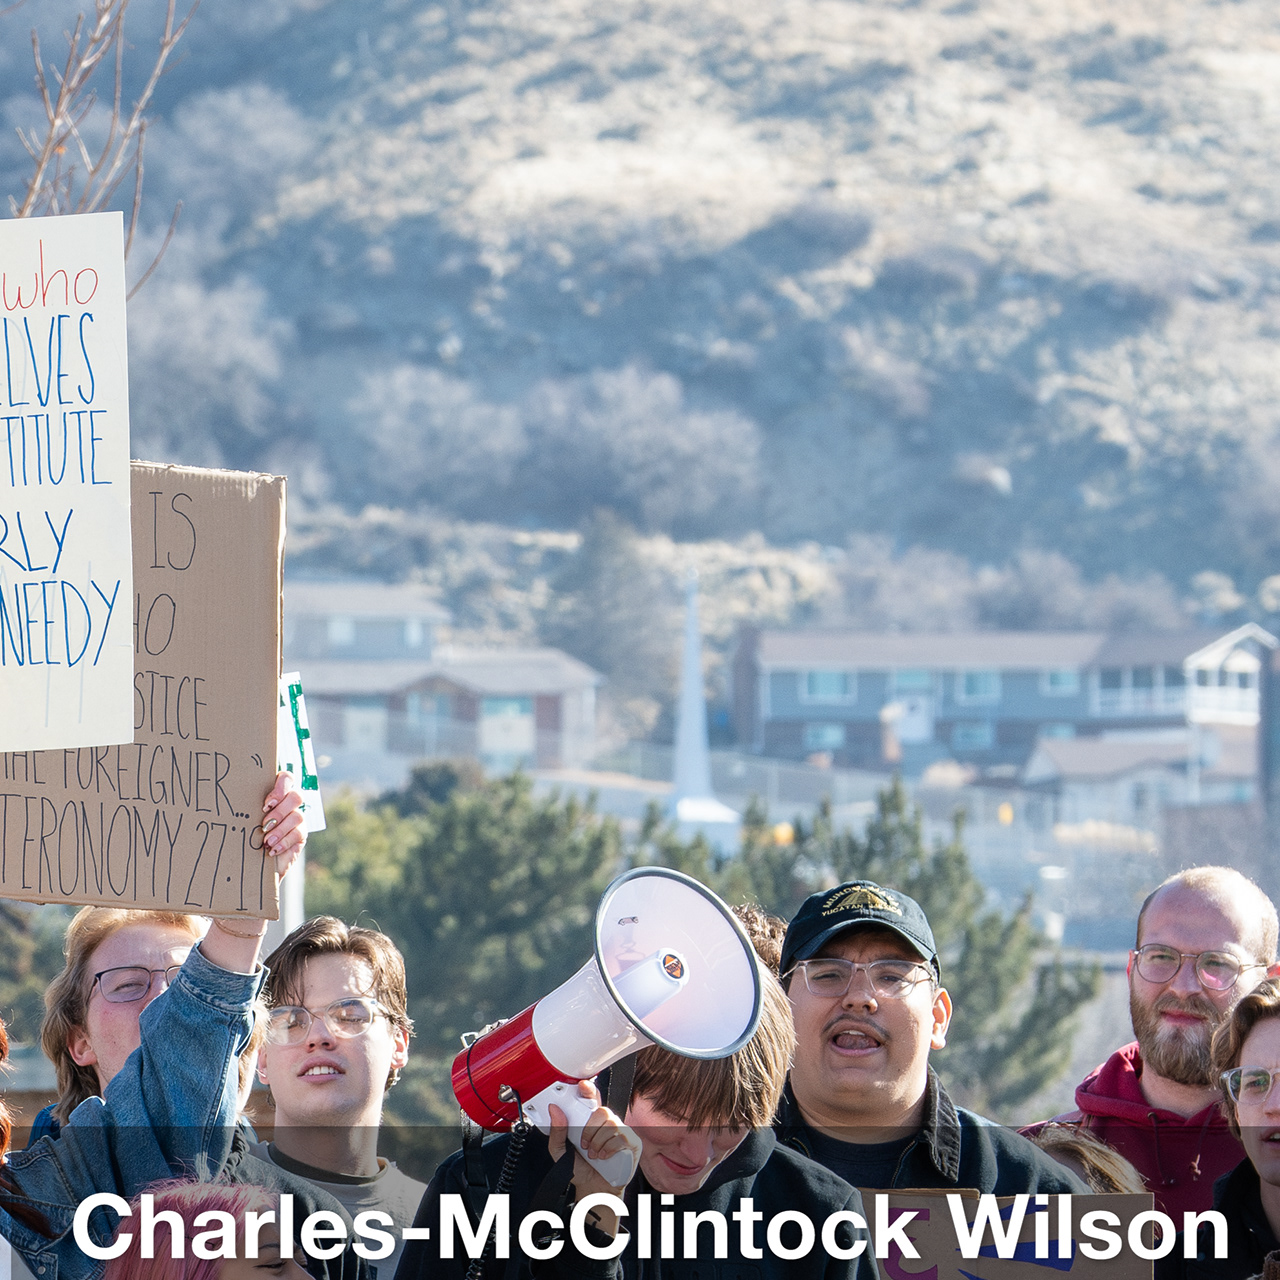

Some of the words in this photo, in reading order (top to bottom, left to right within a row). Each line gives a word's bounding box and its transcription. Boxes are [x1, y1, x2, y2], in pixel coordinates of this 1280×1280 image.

[3, 239, 99, 311] who
[149, 491, 197, 571] IS
[183, 818, 269, 912] 27:19
